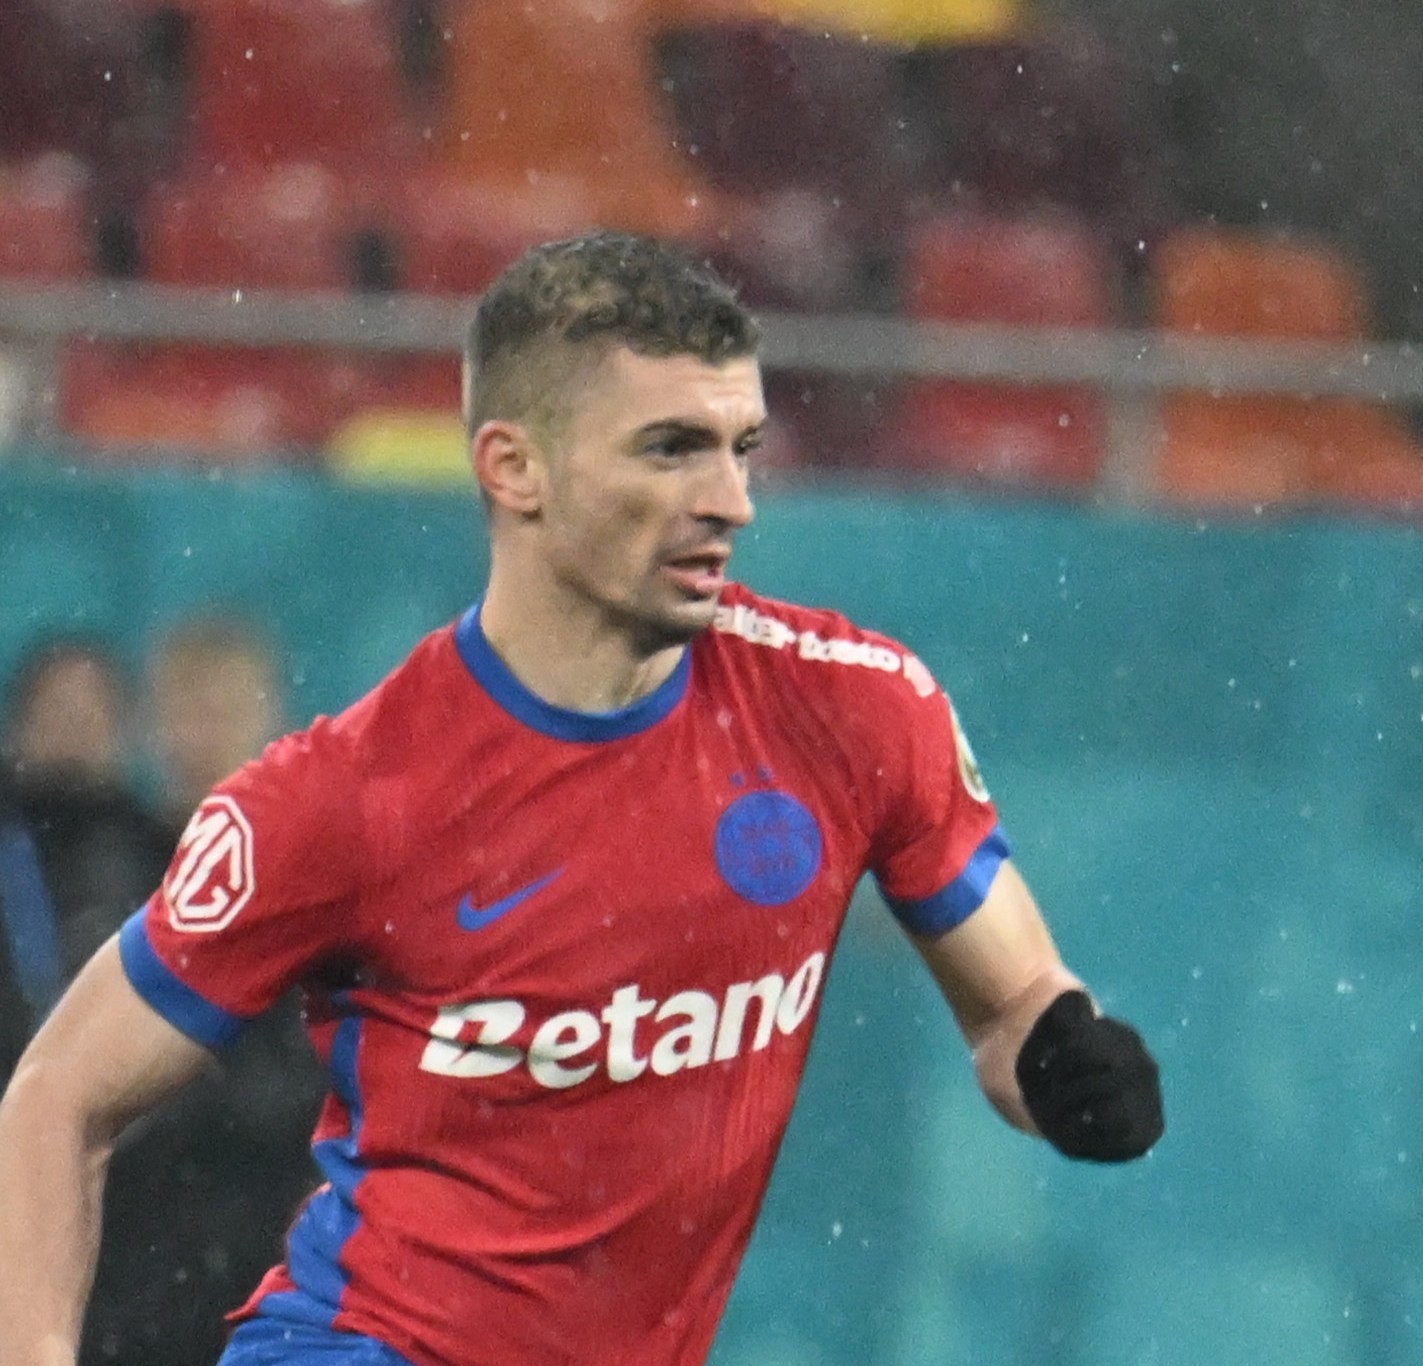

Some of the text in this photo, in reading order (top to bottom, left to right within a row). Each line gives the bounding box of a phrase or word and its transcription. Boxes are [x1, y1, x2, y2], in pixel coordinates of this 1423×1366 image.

[712, 604, 797, 650] alter
[167, 808, 245, 920] MG
[418, 951, 826, 1089] Betano
